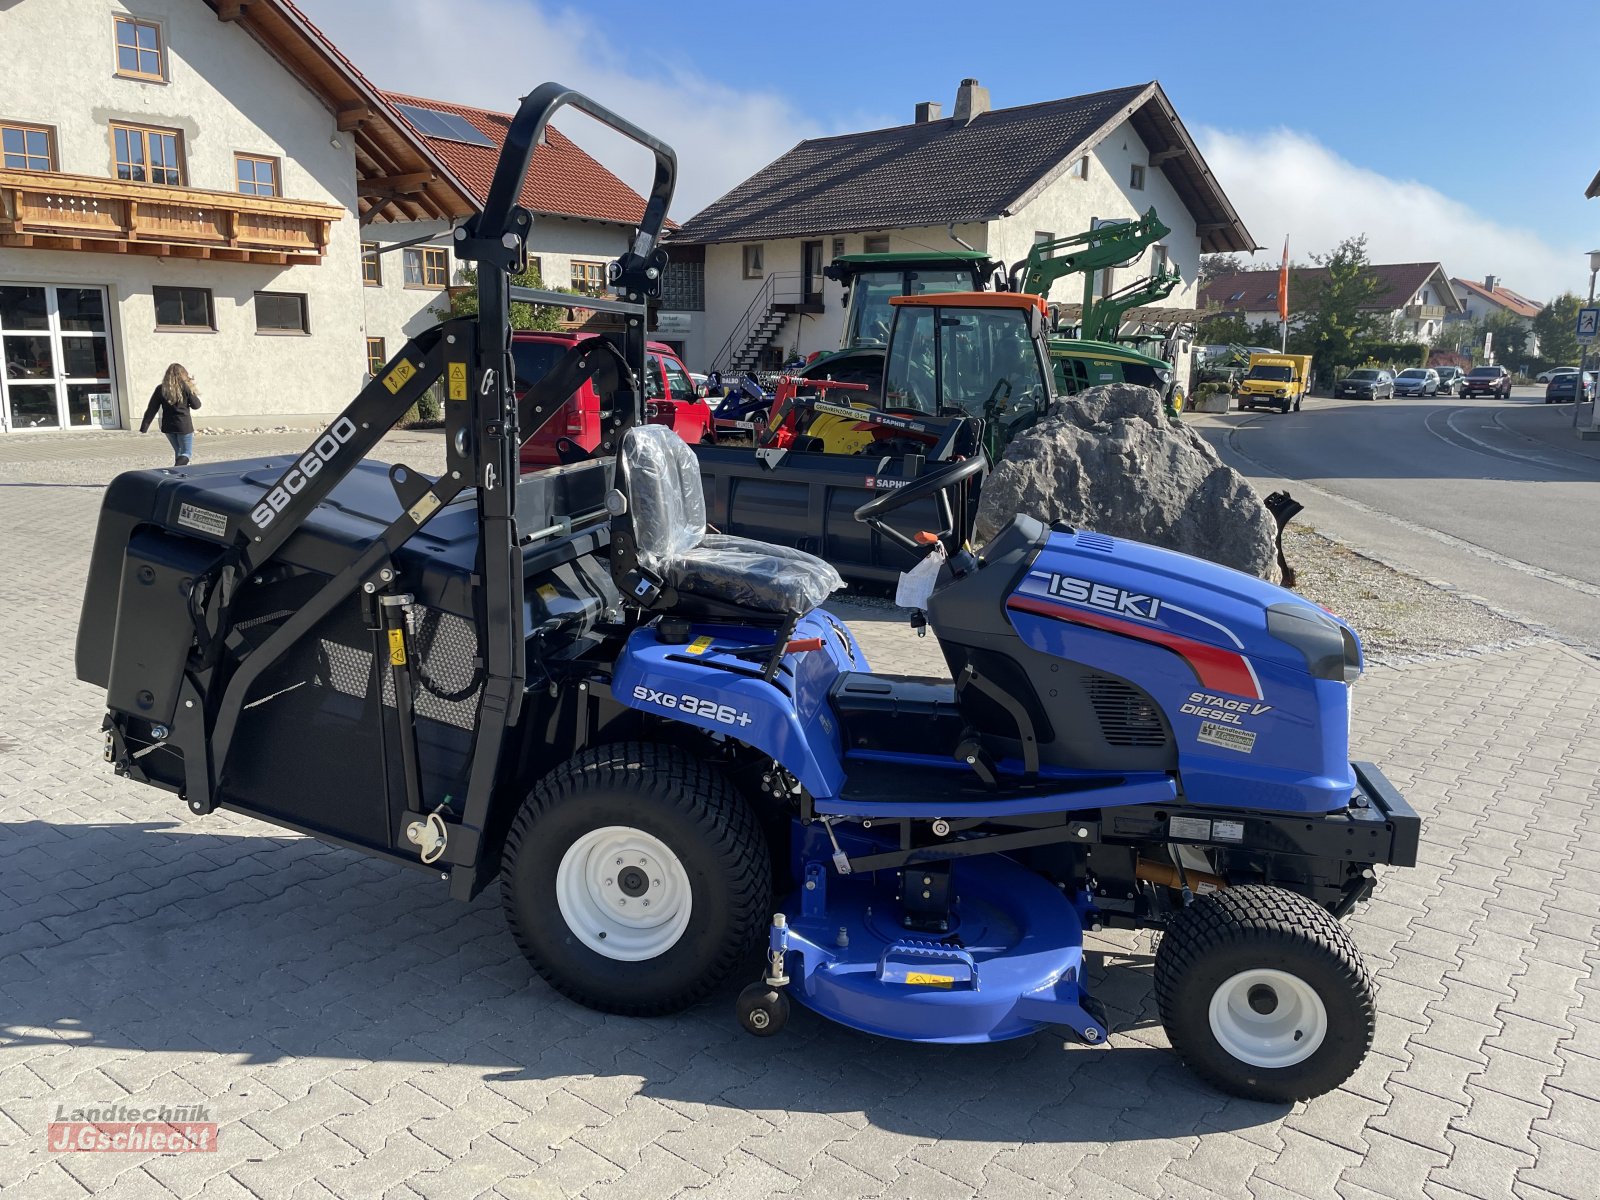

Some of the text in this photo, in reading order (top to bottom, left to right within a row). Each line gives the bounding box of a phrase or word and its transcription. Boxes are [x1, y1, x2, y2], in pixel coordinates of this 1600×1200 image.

[815, 403, 853, 417] GEFAHRENZONE
[882, 418, 906, 428] SAPHIR
[251, 416, 357, 529] SBC600
[1048, 572, 1161, 620] ISEKI
[633, 685, 752, 728] SXG 326+
[1179, 703, 1243, 725] DIESEL
[1188, 692, 1250, 715] STAGE
[1217, 725, 1256, 738] Landtechnik
